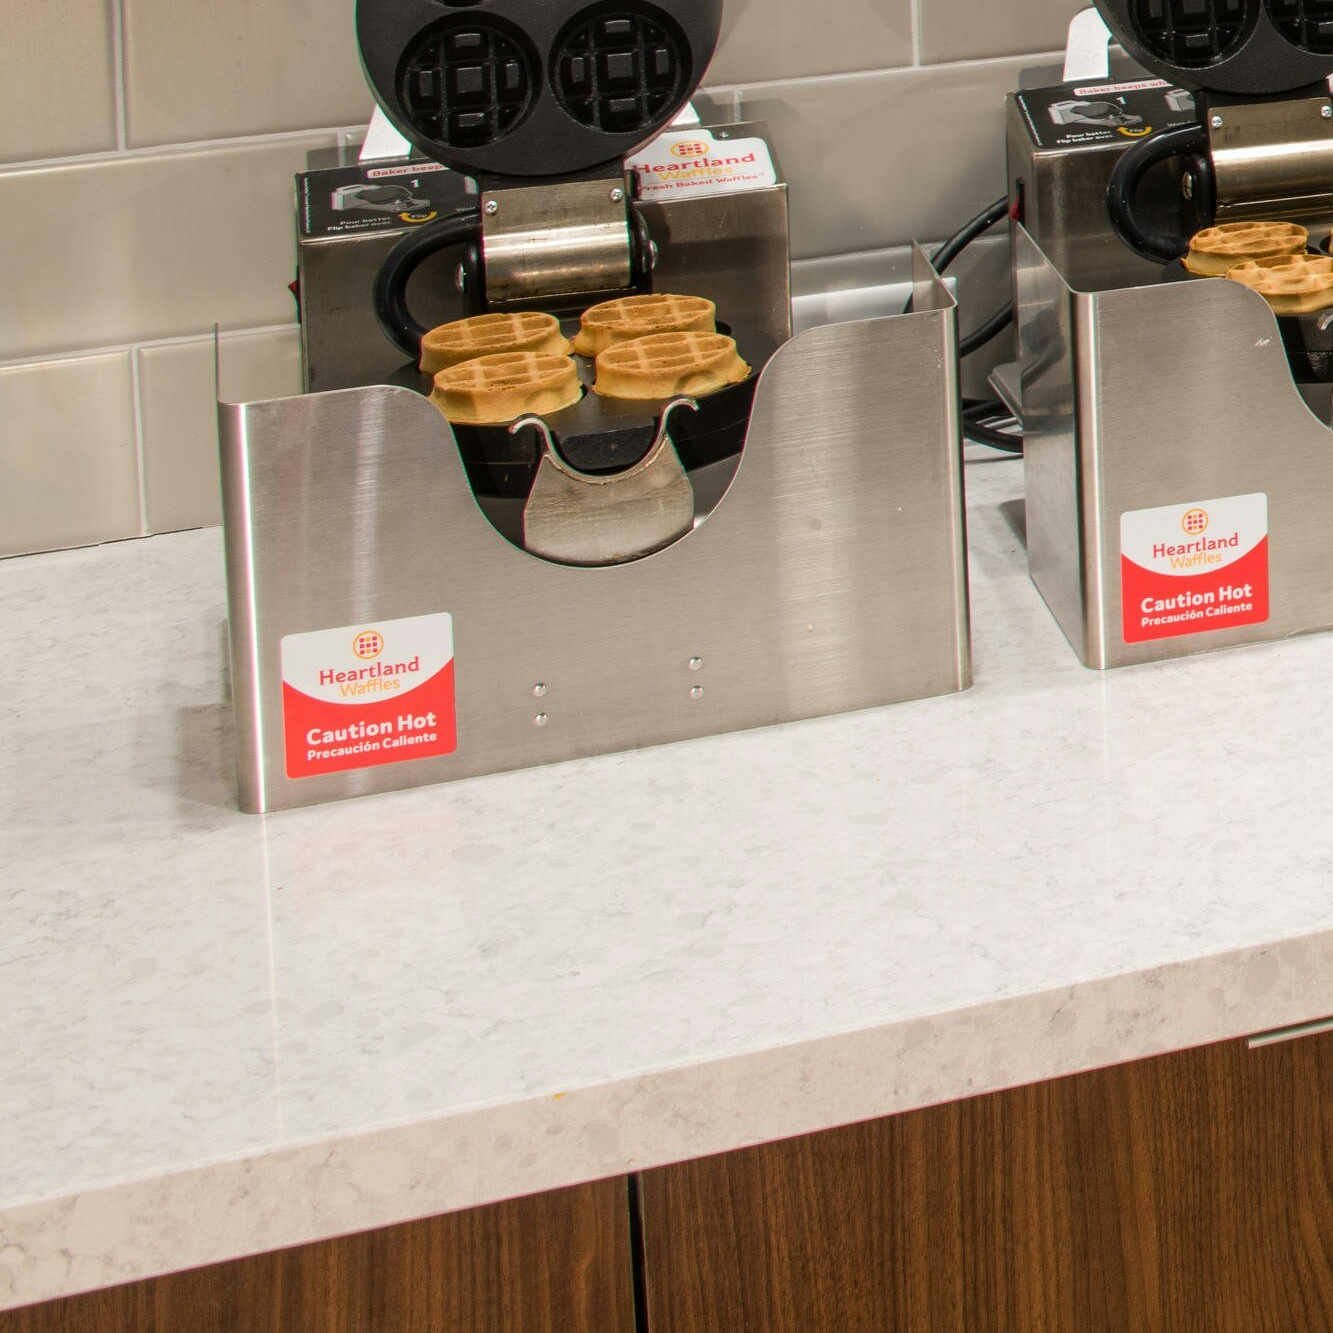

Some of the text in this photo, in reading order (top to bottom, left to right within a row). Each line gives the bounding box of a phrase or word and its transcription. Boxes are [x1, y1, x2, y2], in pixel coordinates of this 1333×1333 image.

[1079, 86, 1110, 95] Baker
[1113, 83, 1148, 93] beeps
[1116, 96, 1126, 105] 1
[372, 164, 443, 177] Baker beep
[632, 153, 756, 174] Heartland
[411, 178, 420, 188] 1
[657, 166, 734, 182] Waffles
[676, 179, 713, 188] Baked
[1153, 532, 1239, 558] Heartland
[1170, 551, 1222, 570] Waffles
[1141, 583, 1253, 614] Caution Hot
[1141, 601, 1253, 627] Precaución Caliente
[319, 656, 420, 686] Heartland
[340, 678, 400, 697] Waffles
[306, 712, 437, 746] Caution Hot
[307, 731, 438, 761] Precaución Caliente
